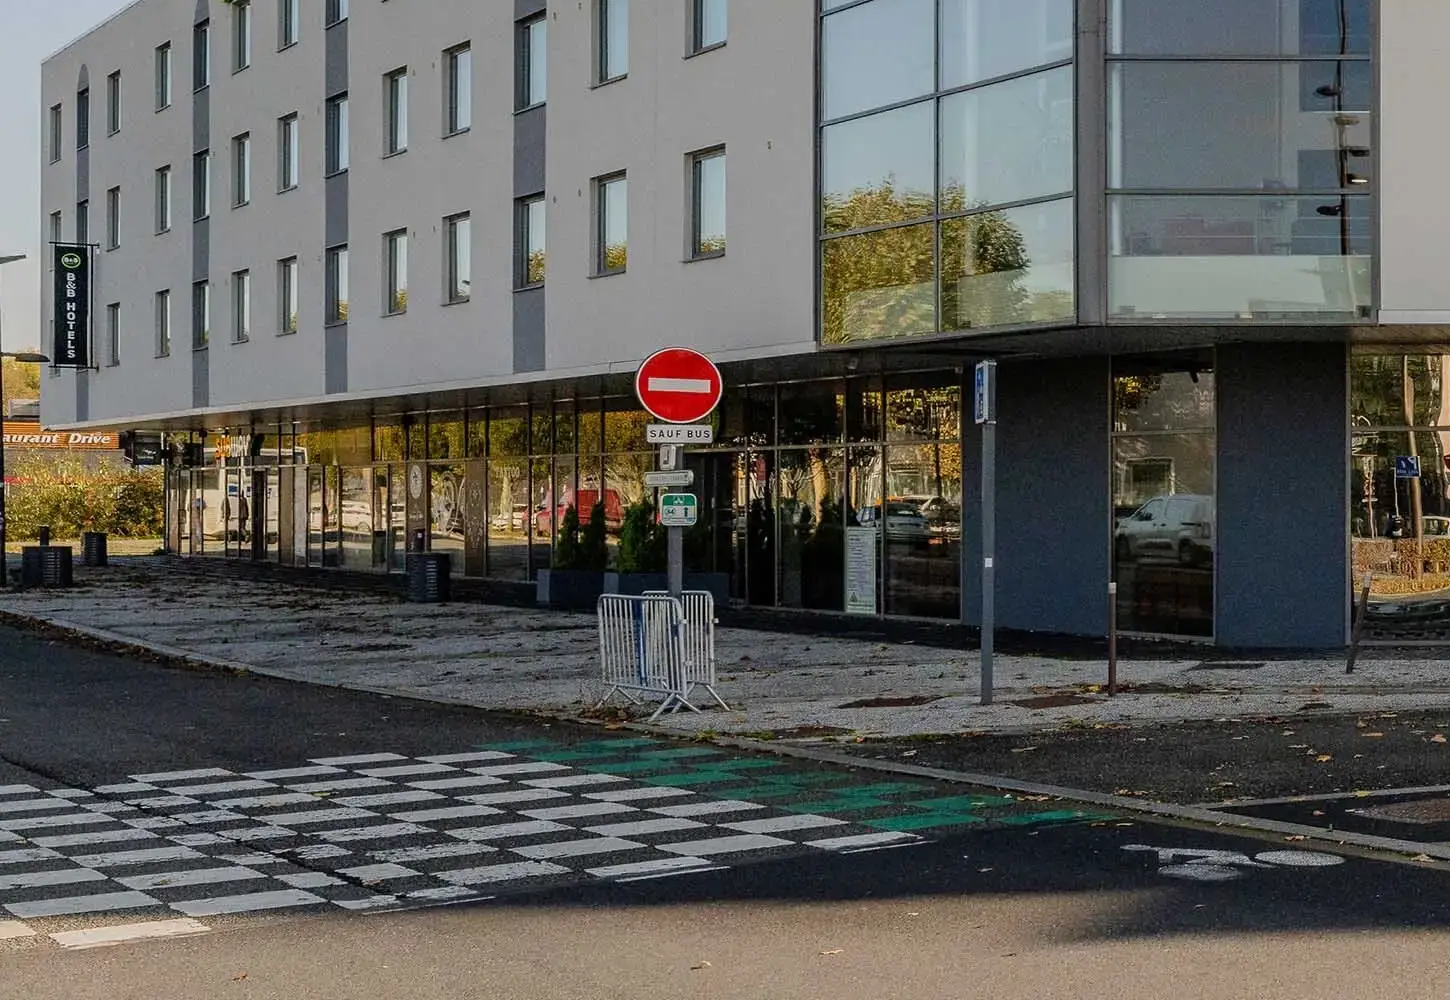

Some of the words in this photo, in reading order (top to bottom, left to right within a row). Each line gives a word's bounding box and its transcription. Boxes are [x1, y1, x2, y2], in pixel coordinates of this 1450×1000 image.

[66, 272, 77, 298] B&B
[66, 302, 76, 358] HOTELS
[69, 432, 111, 444] Drive
[650, 430, 682, 438] SAUF
[687, 430, 711, 439] BUS
